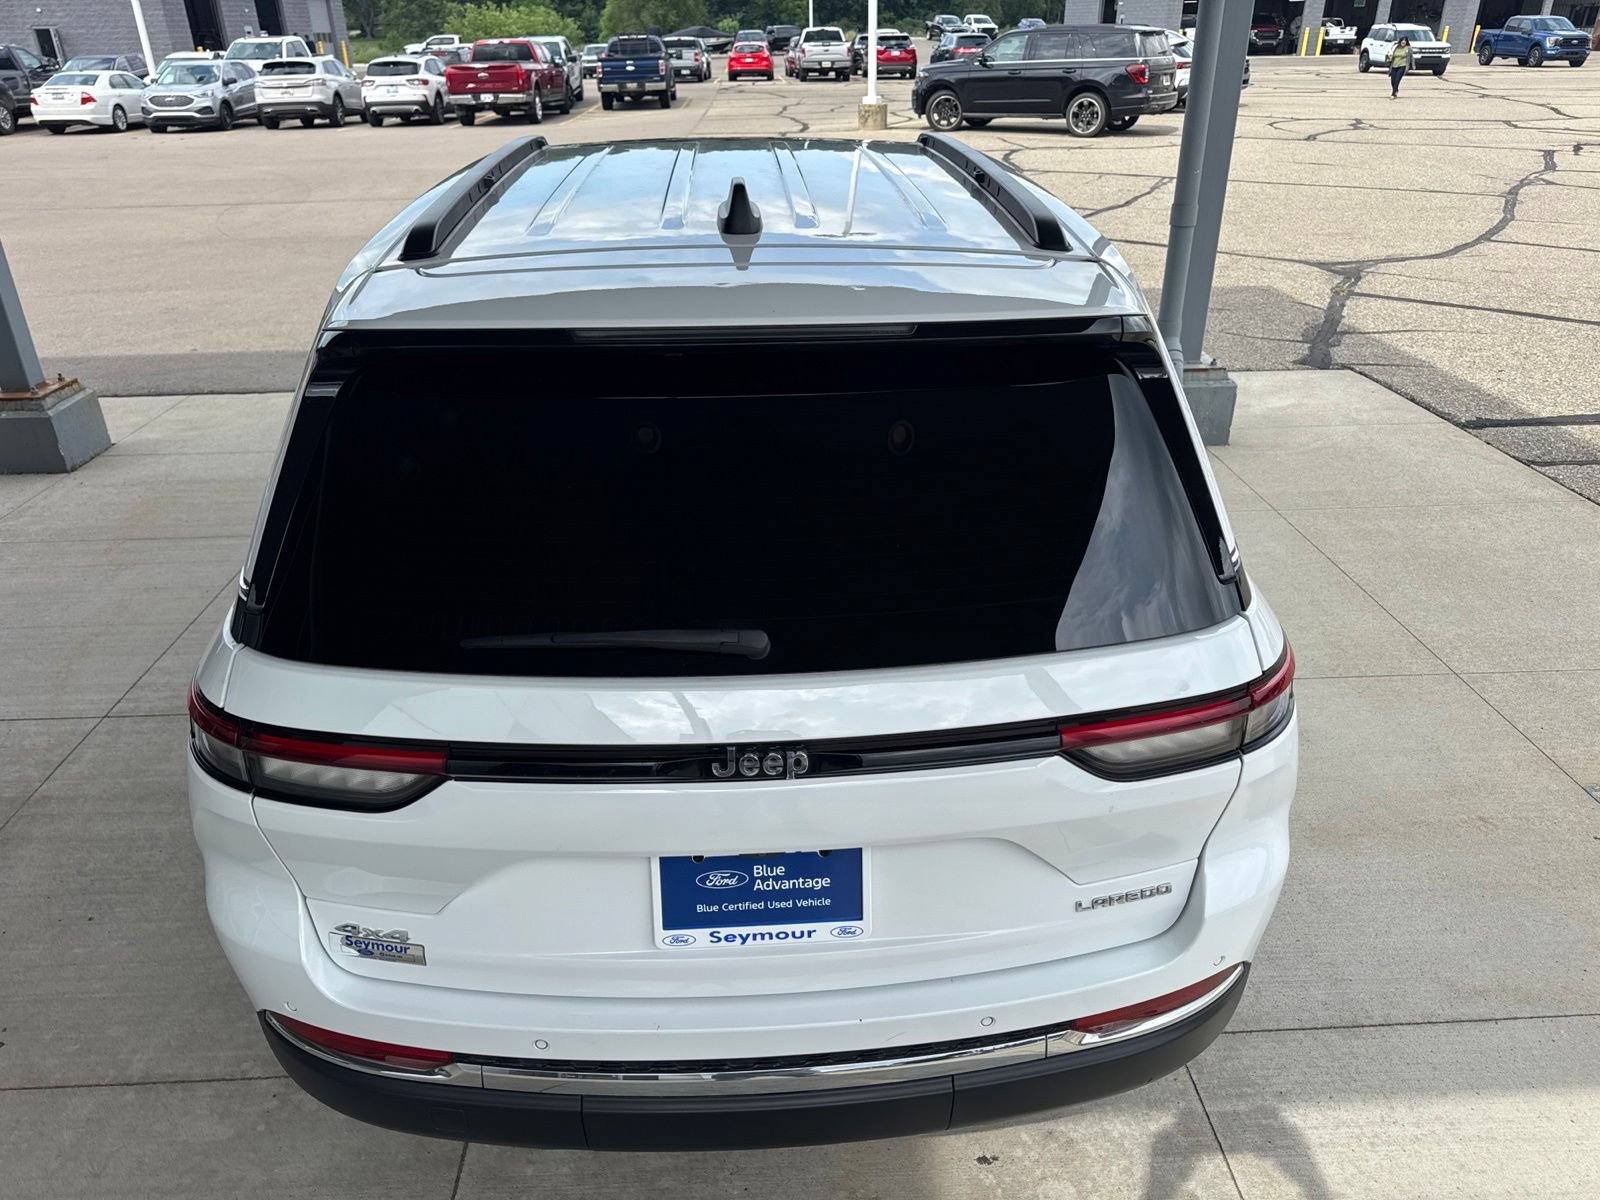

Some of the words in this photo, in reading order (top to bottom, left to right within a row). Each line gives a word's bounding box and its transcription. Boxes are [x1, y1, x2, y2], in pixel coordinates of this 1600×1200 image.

[711, 746, 809, 780] Jeep
[753, 864, 786, 877] Blue
[705, 872, 739, 887] Ford
[753, 875, 831, 891] Advantage
[696, 903, 719, 913] Blue
[722, 901, 765, 911] Certified
[767, 899, 793, 909] Used
[795, 897, 831, 908] Vehicle
[1075, 882, 1172, 912] LAREDO
[334, 922, 410, 943] 4x4
[709, 928, 817, 945] Seymour
[345, 935, 411, 954] Seymour
